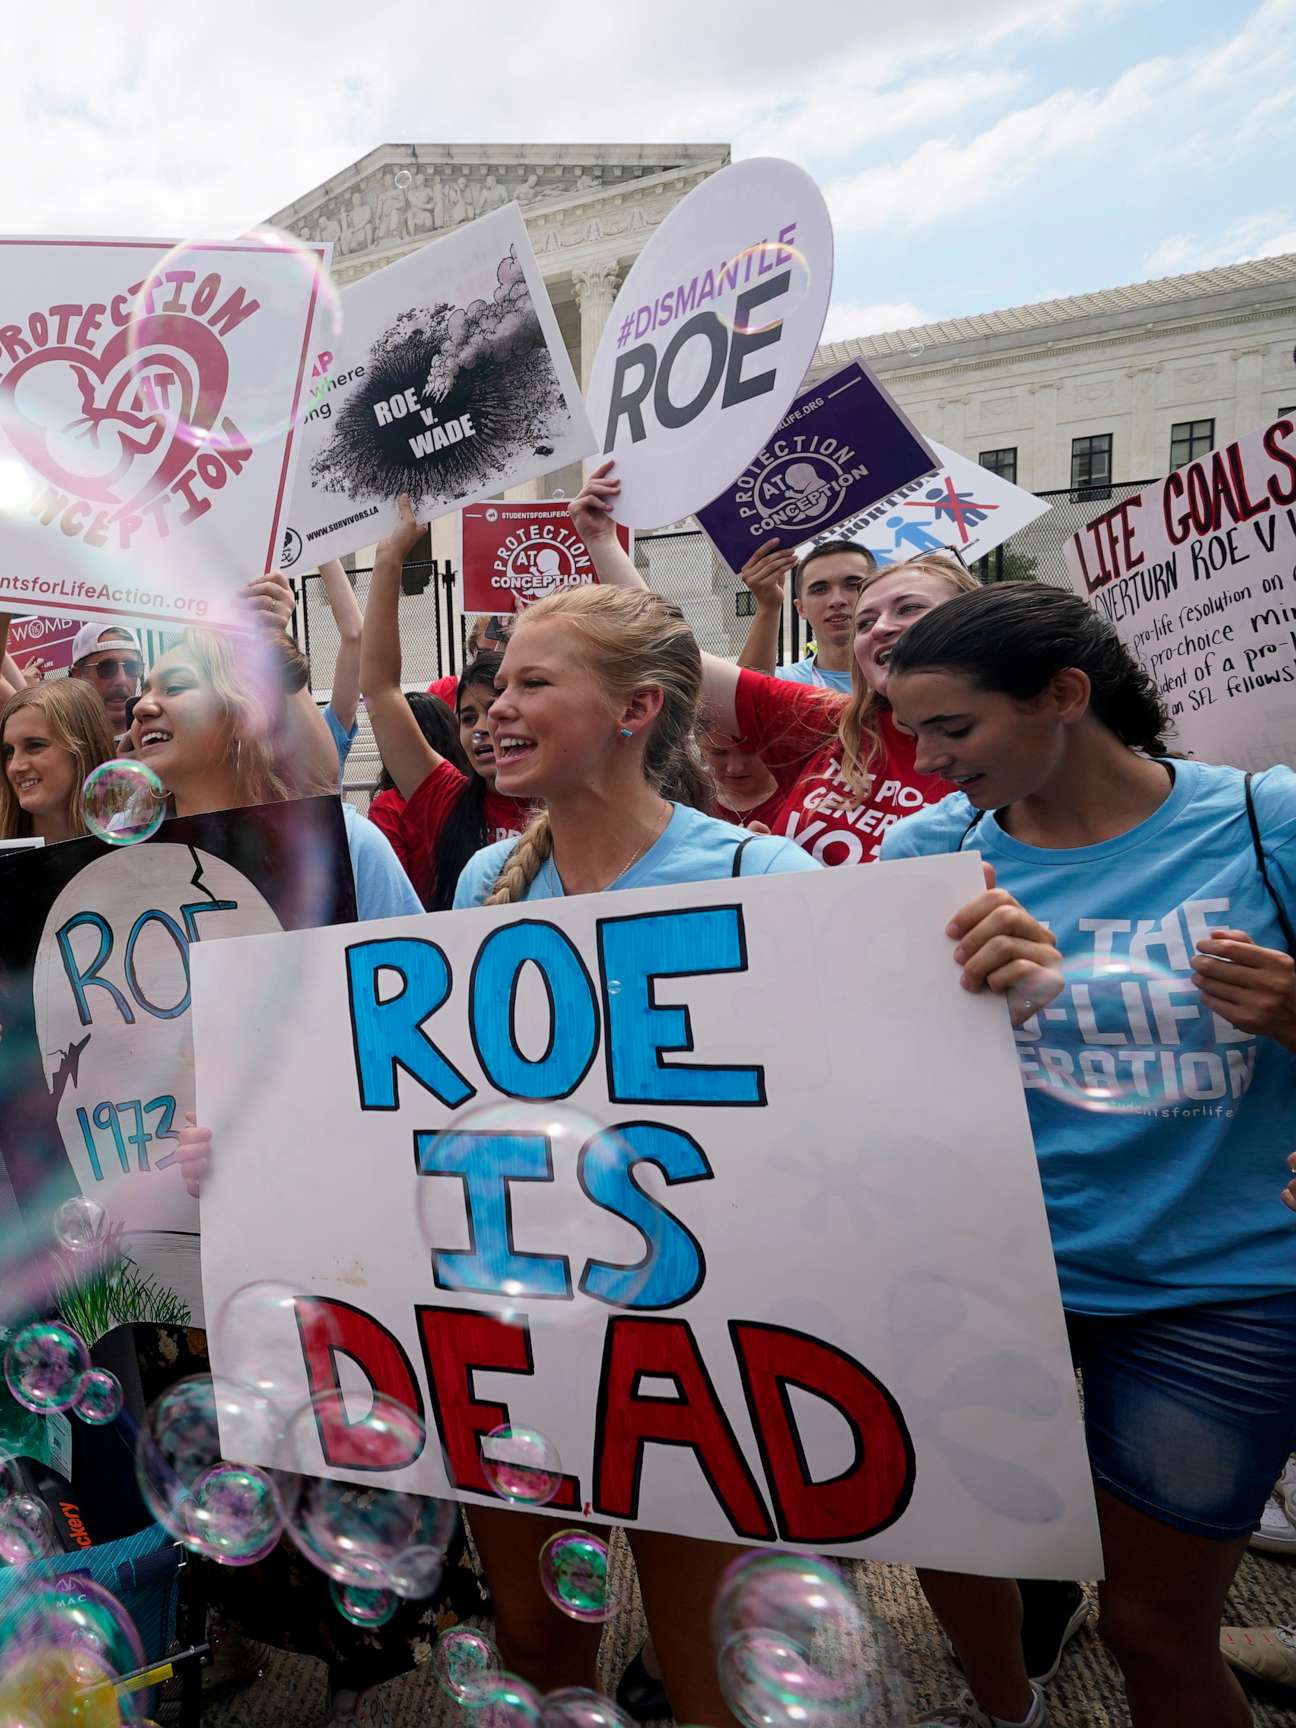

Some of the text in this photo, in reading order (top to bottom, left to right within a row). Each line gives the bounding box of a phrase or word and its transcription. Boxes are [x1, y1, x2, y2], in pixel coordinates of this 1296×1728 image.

[616, 221, 797, 350] #DISMANTLE
[602, 269, 792, 456] ROE
[129, 371, 177, 413] AT
[372, 386, 422, 427] ROE
[408, 413, 476, 460] WADE
[419, 407, 440, 427] V.
[24, 415, 254, 551] NCEPTION
[735, 435, 856, 519] PROTECTION
[749, 464, 870, 537] CONCEPTION
[761, 474, 787, 501] AT
[305, 505, 380, 543] WWW.SURVIVORS.LA
[1072, 418, 1296, 596] LIFE GOALS
[493, 524, 591, 572] PROTECTION
[516, 550, 538, 566] AT
[1093, 513, 1277, 623] OVERTURN ROE V
[490, 572, 593, 589] CONCEPTION
[1132, 573, 1284, 659] pro-life resolution on
[1150, 624, 1235, 681] pro-choice
[1194, 651, 1216, 682] of
[1222, 657, 1235, 672] a
[1171, 700, 1185, 716] an
[1188, 686, 1218, 712] SFL
[345, 903, 768, 1112] ROE
[1106, 1100, 1234, 1119] tudentsforlife
[413, 1119, 715, 1311] IS
[292, 1294, 917, 1544] DEAD
[58, 1501, 92, 1549] ckery
[55, 1594, 89, 1609] MAC
